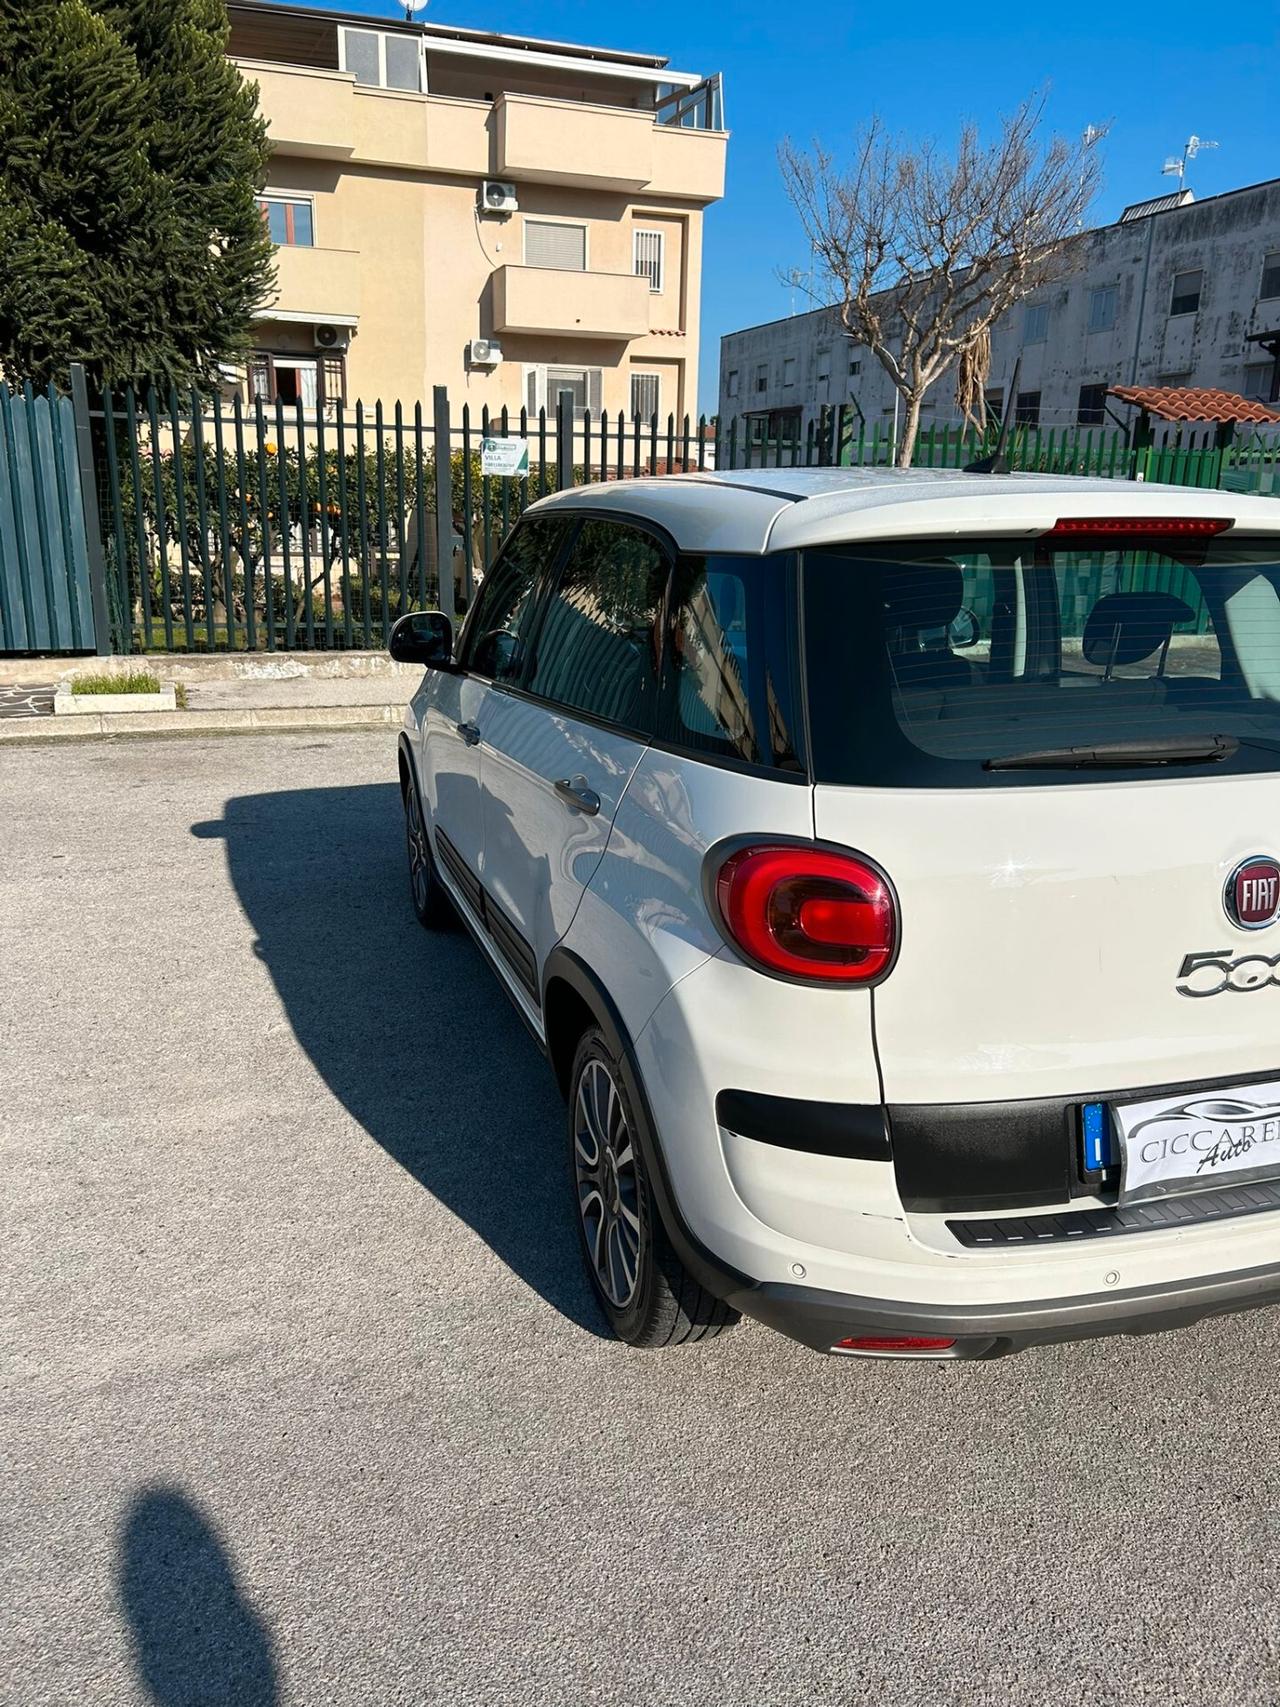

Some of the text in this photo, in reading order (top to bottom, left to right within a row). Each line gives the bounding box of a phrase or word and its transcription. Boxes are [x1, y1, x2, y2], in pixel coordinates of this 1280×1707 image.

[1241, 877, 1278, 912] FIAT
[1175, 949, 1280, 998] 50
[1140, 1120, 1280, 1164] CICCARE
[1196, 1138, 1253, 1174] Auto
